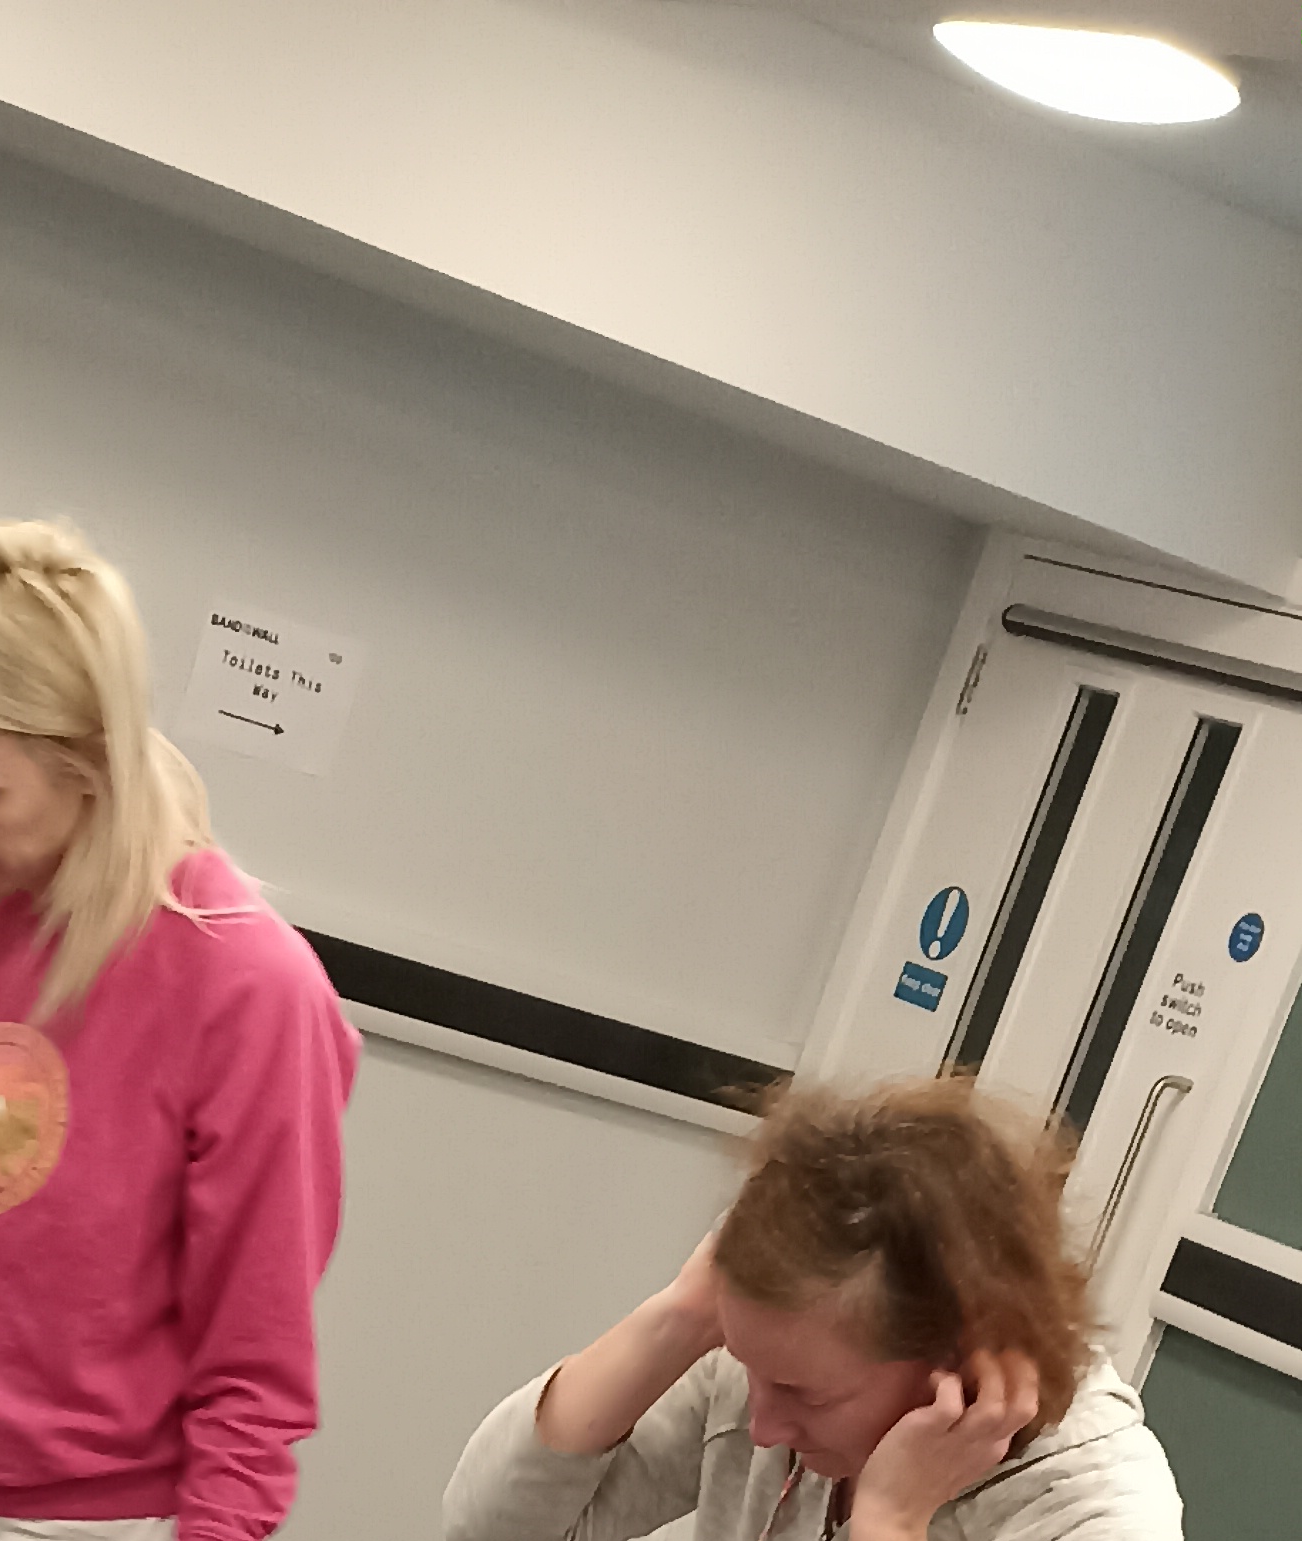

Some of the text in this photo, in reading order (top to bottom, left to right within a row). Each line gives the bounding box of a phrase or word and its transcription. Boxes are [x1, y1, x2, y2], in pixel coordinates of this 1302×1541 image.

[222, 649, 322, 693] Toilets This
[252, 683, 279, 703] Way
[1172, 973, 1206, 998] Push
[1160, 994, 1202, 1017] switch
[1166, 1018, 1198, 1038] open
